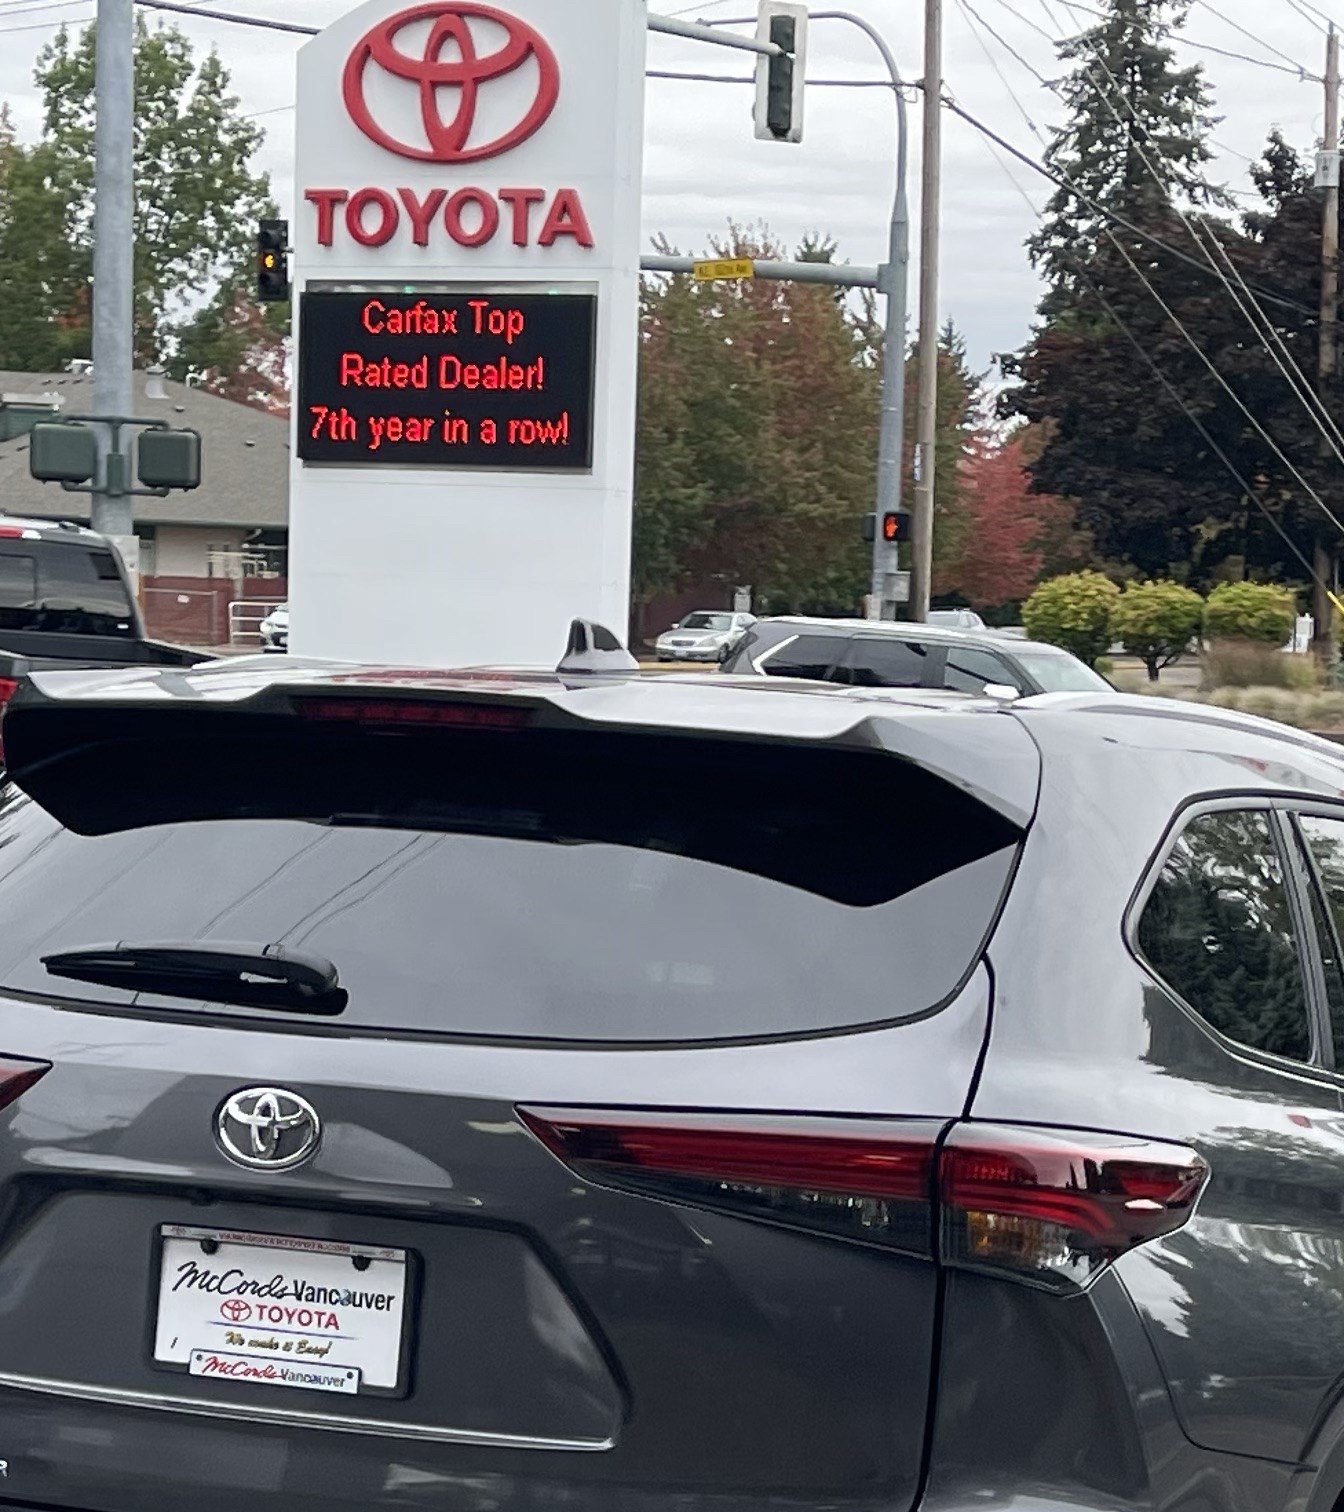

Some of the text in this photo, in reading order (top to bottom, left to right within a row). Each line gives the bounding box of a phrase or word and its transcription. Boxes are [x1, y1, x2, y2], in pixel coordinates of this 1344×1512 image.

[304, 187, 595, 248] TOYOTA
[361, 299, 525, 345] Carfax Top
[340, 353, 544, 390] Rated Dealer!
[309, 406, 569, 450] 7th year in a row!
[255, 1304, 340, 1330] TOYOTA
